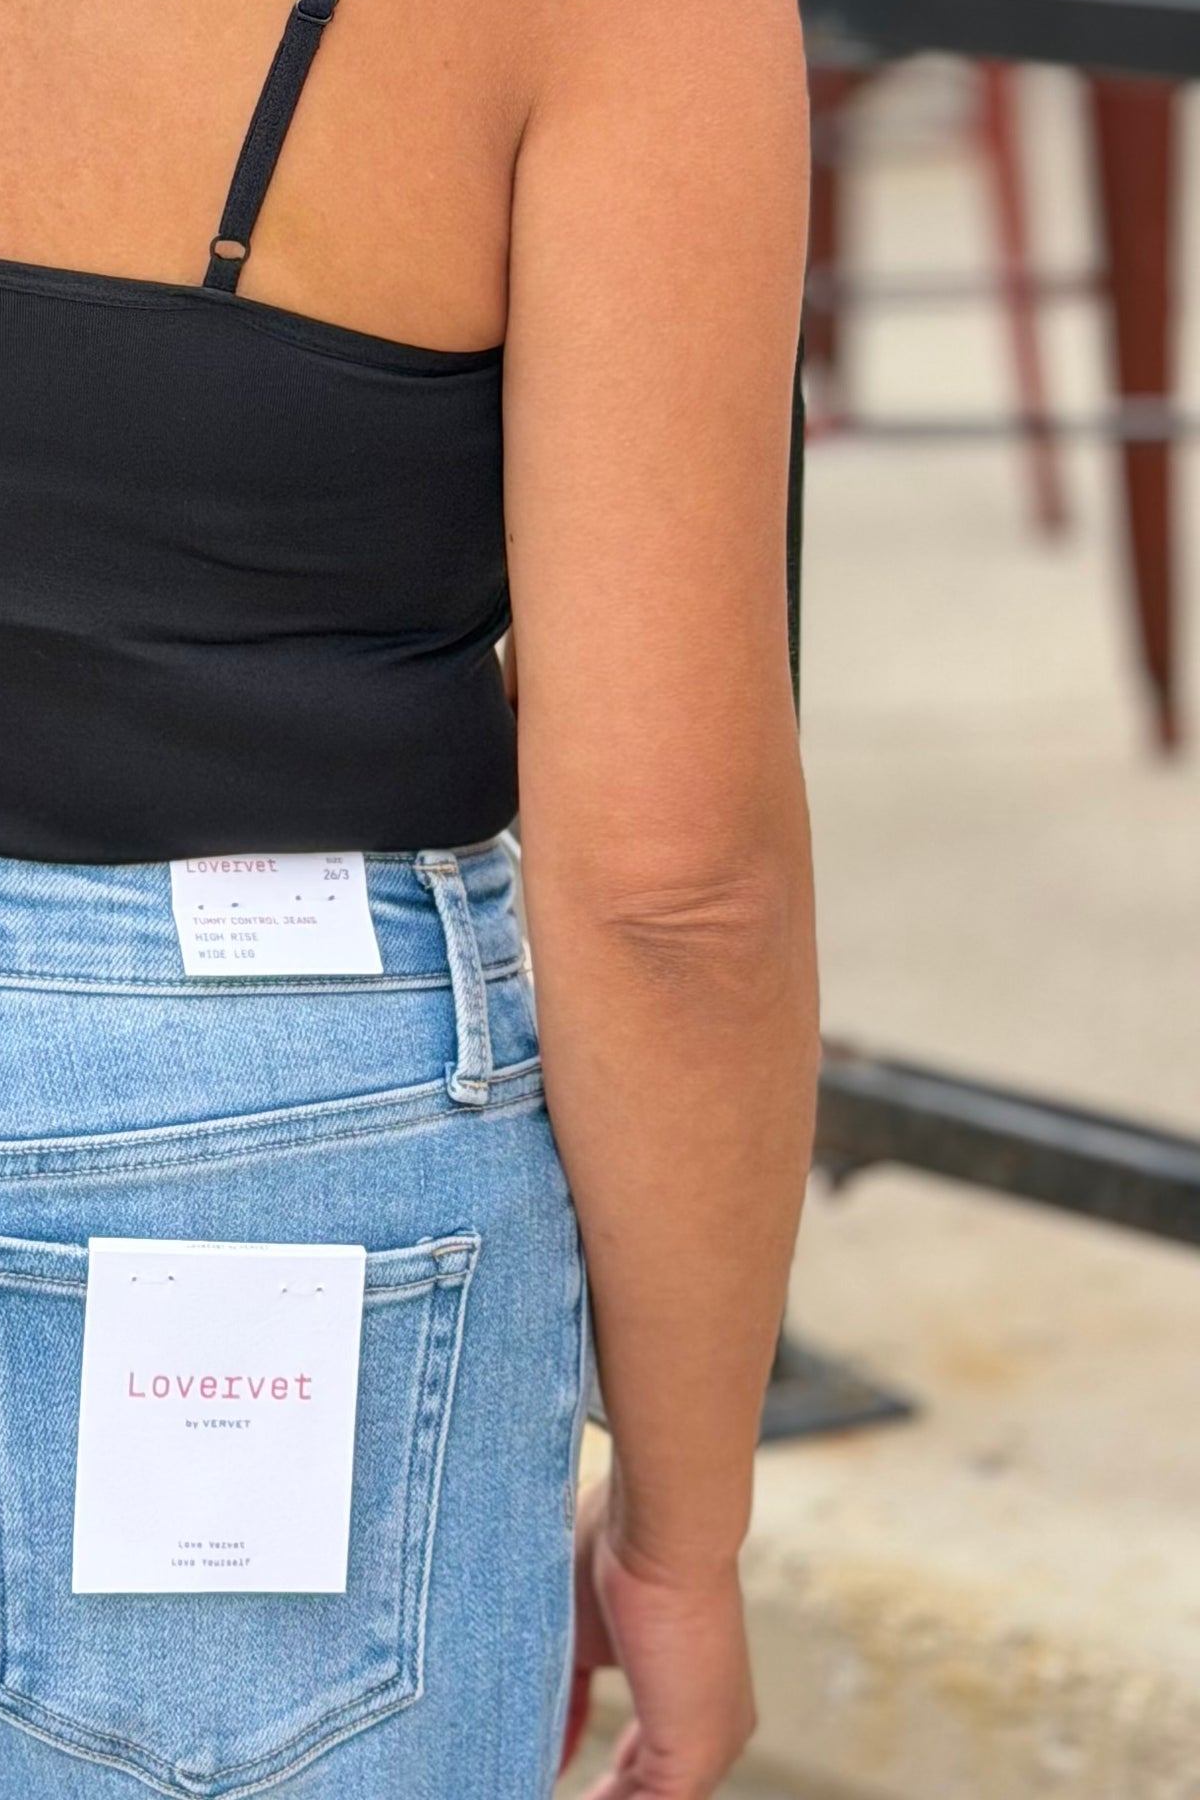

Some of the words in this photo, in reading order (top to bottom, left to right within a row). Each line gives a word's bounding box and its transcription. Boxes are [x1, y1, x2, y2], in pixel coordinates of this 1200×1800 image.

[186, 857, 278, 873] Lovervet
[193, 916, 227, 925] TUMMY
[231, 916, 279, 925] CONTROL
[283, 916, 318, 925] JEANS
[195, 932, 225, 941] HIGH
[230, 932, 258, 941] RISE
[198, 949, 227, 959] WIDE
[234, 949, 256, 959] LEG
[128, 1372, 312, 1400] Lovervet
[185, 1419, 198, 1429] by
[202, 1419, 251, 1428] VERVET
